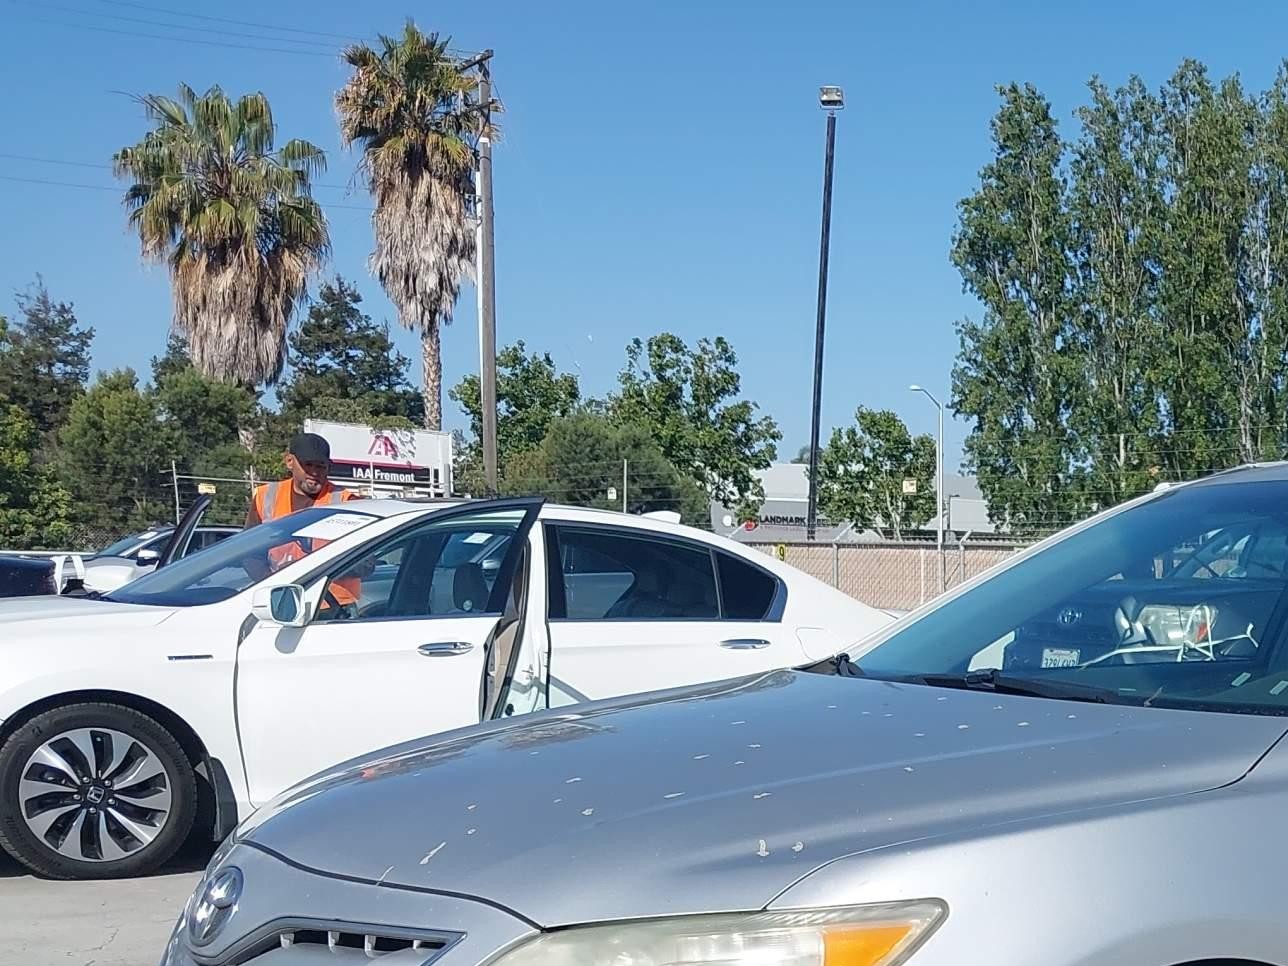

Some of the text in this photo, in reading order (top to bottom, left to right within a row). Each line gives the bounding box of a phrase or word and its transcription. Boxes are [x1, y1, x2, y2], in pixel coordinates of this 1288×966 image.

[353, 467, 415, 482] IAA Fremont
[759, 516, 806, 525] LANDMARK
[778, 545, 785, 561] 9
